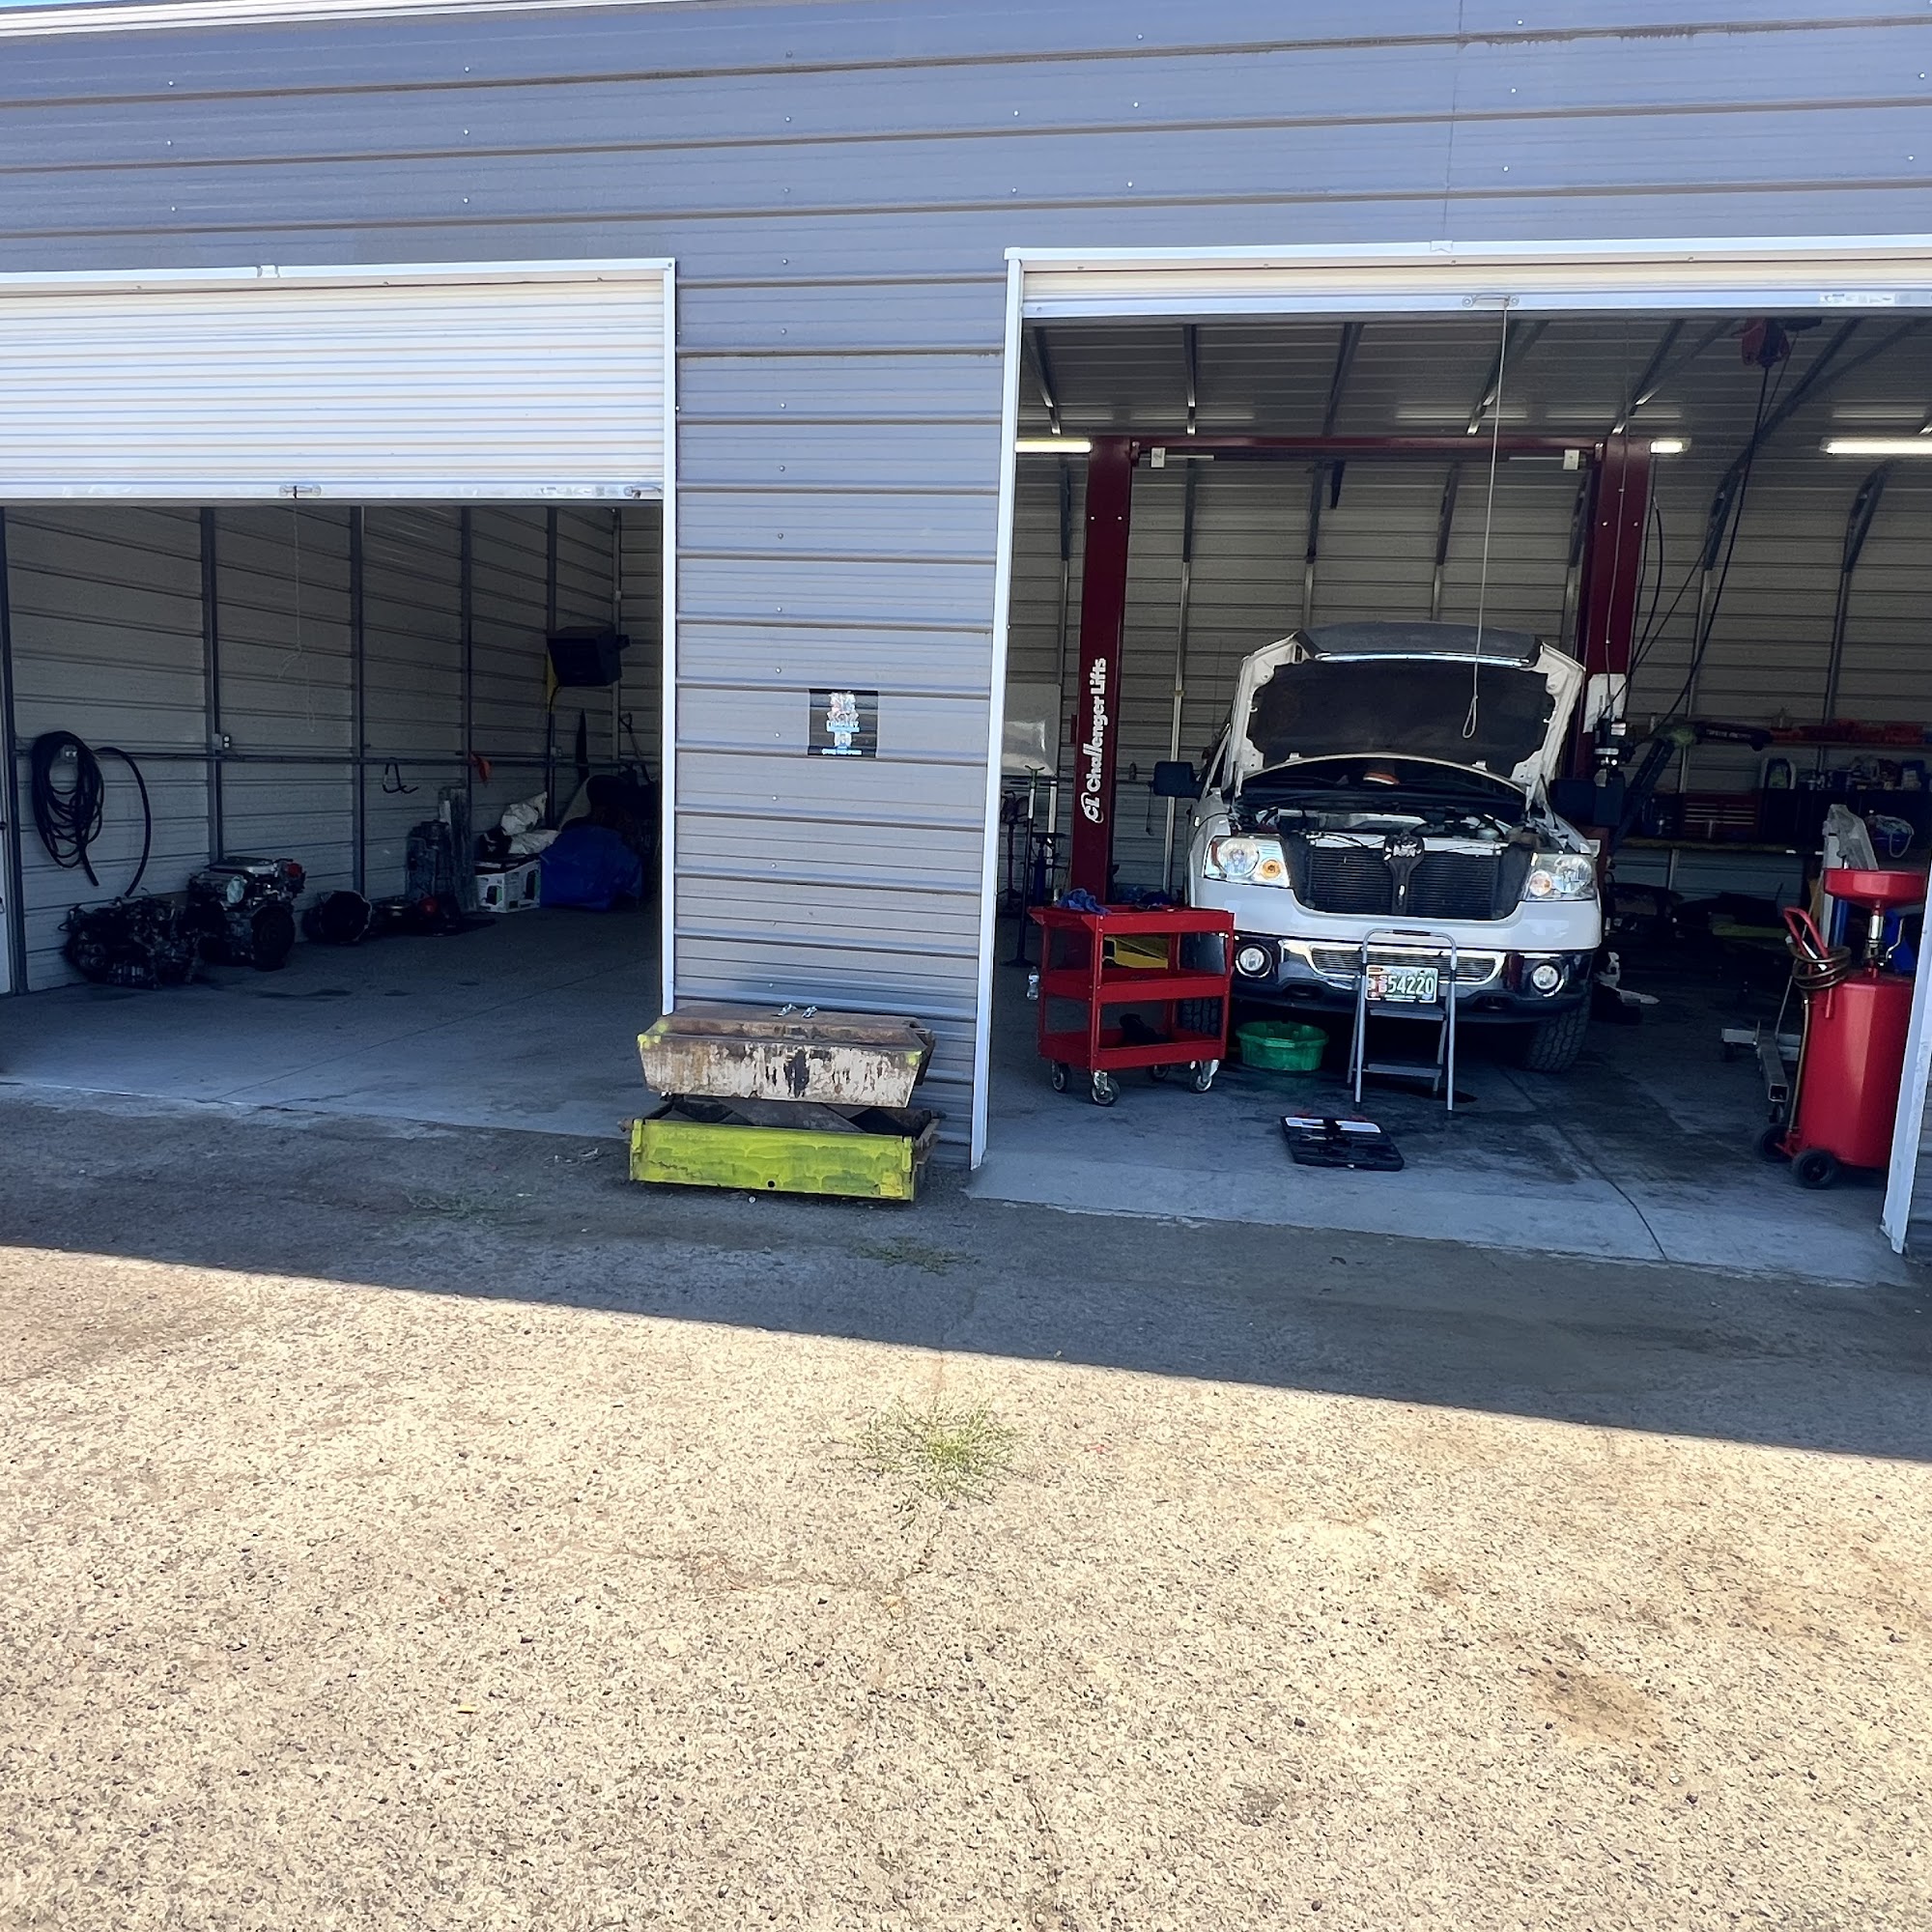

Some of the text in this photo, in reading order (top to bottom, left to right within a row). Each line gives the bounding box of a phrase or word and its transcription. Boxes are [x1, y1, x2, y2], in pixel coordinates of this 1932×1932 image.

[1090, 658, 1107, 695] Lifts
[1083, 696, 1108, 792] Challenger
[1388, 976, 1435, 994] 54220
